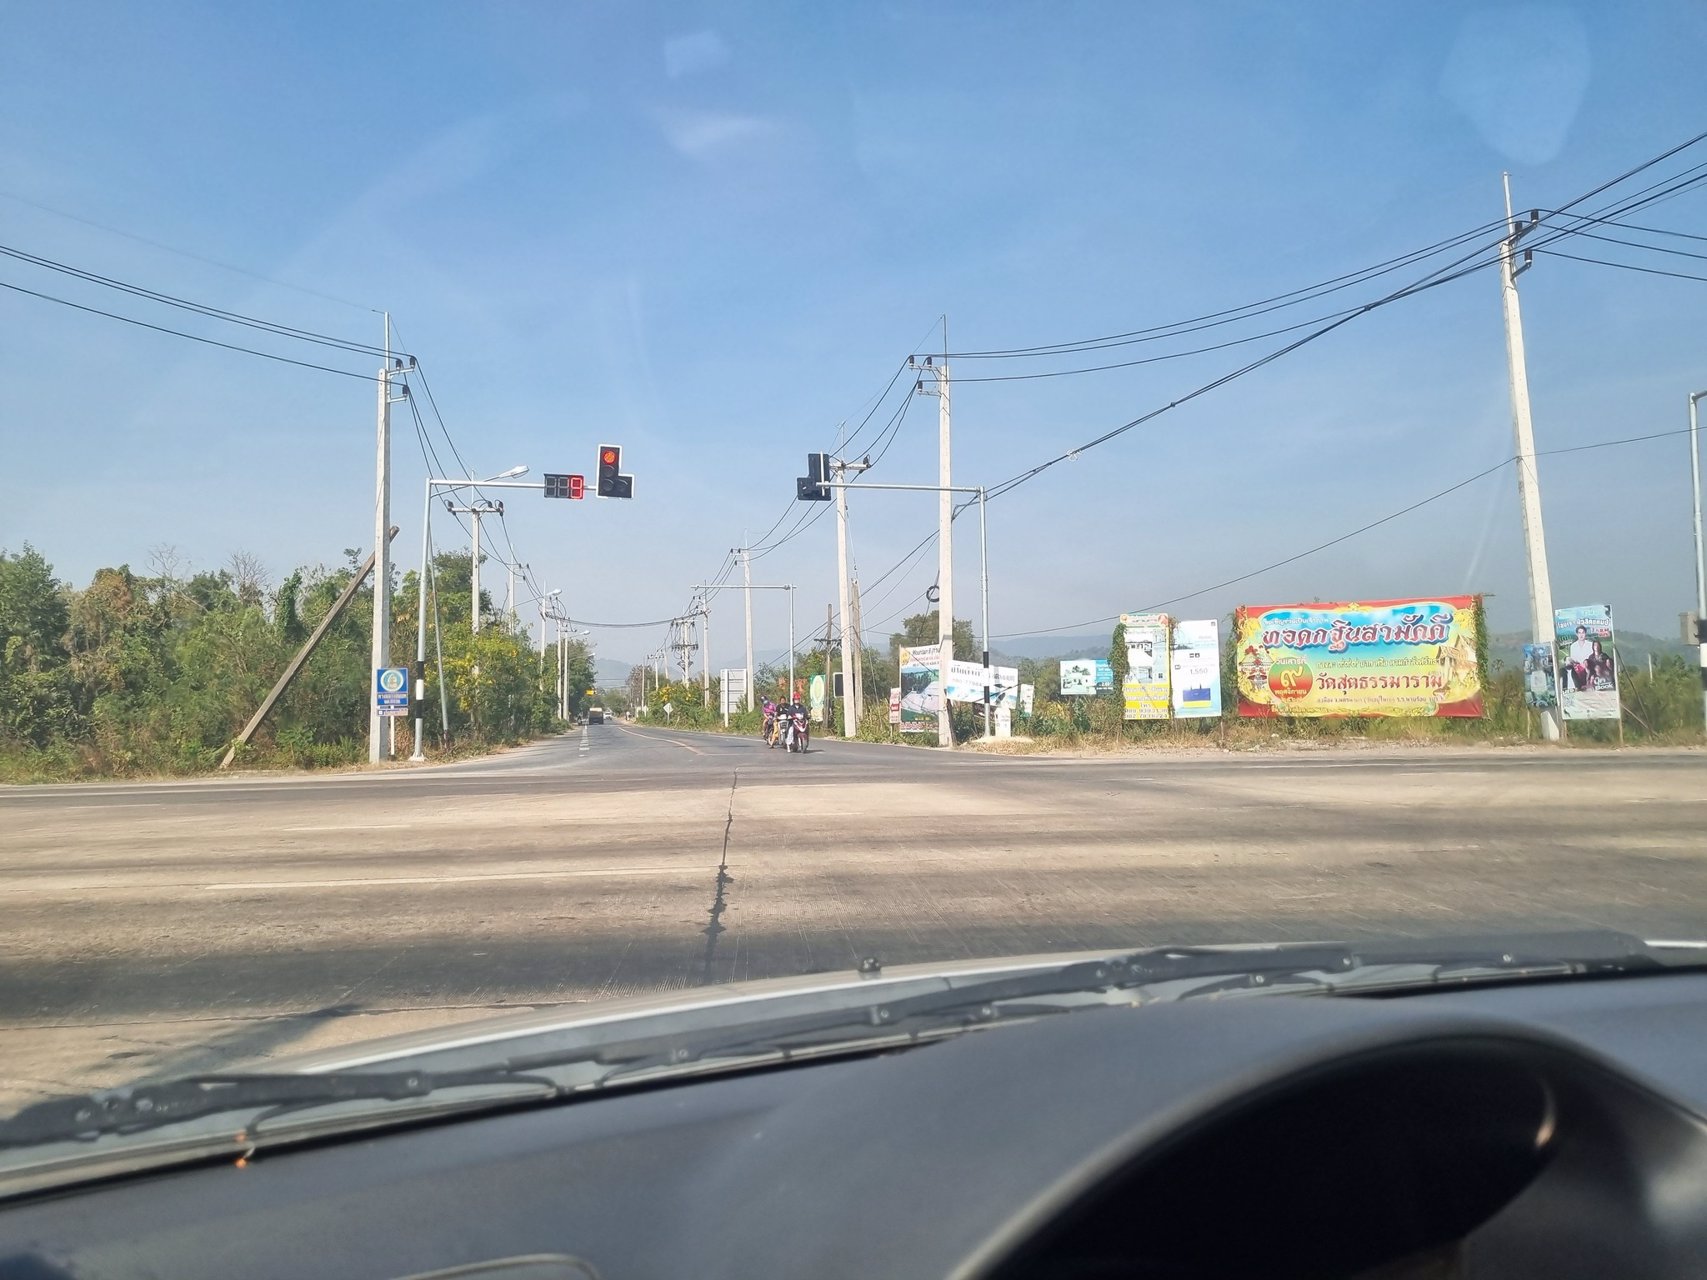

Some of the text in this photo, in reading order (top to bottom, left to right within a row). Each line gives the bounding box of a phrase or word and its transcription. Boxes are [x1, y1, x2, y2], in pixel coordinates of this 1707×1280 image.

[1262, 613, 1452, 652] ทอดกฐินสามัคคี
[1316, 672, 1442, 696] วัดสุตธรรมาราม
